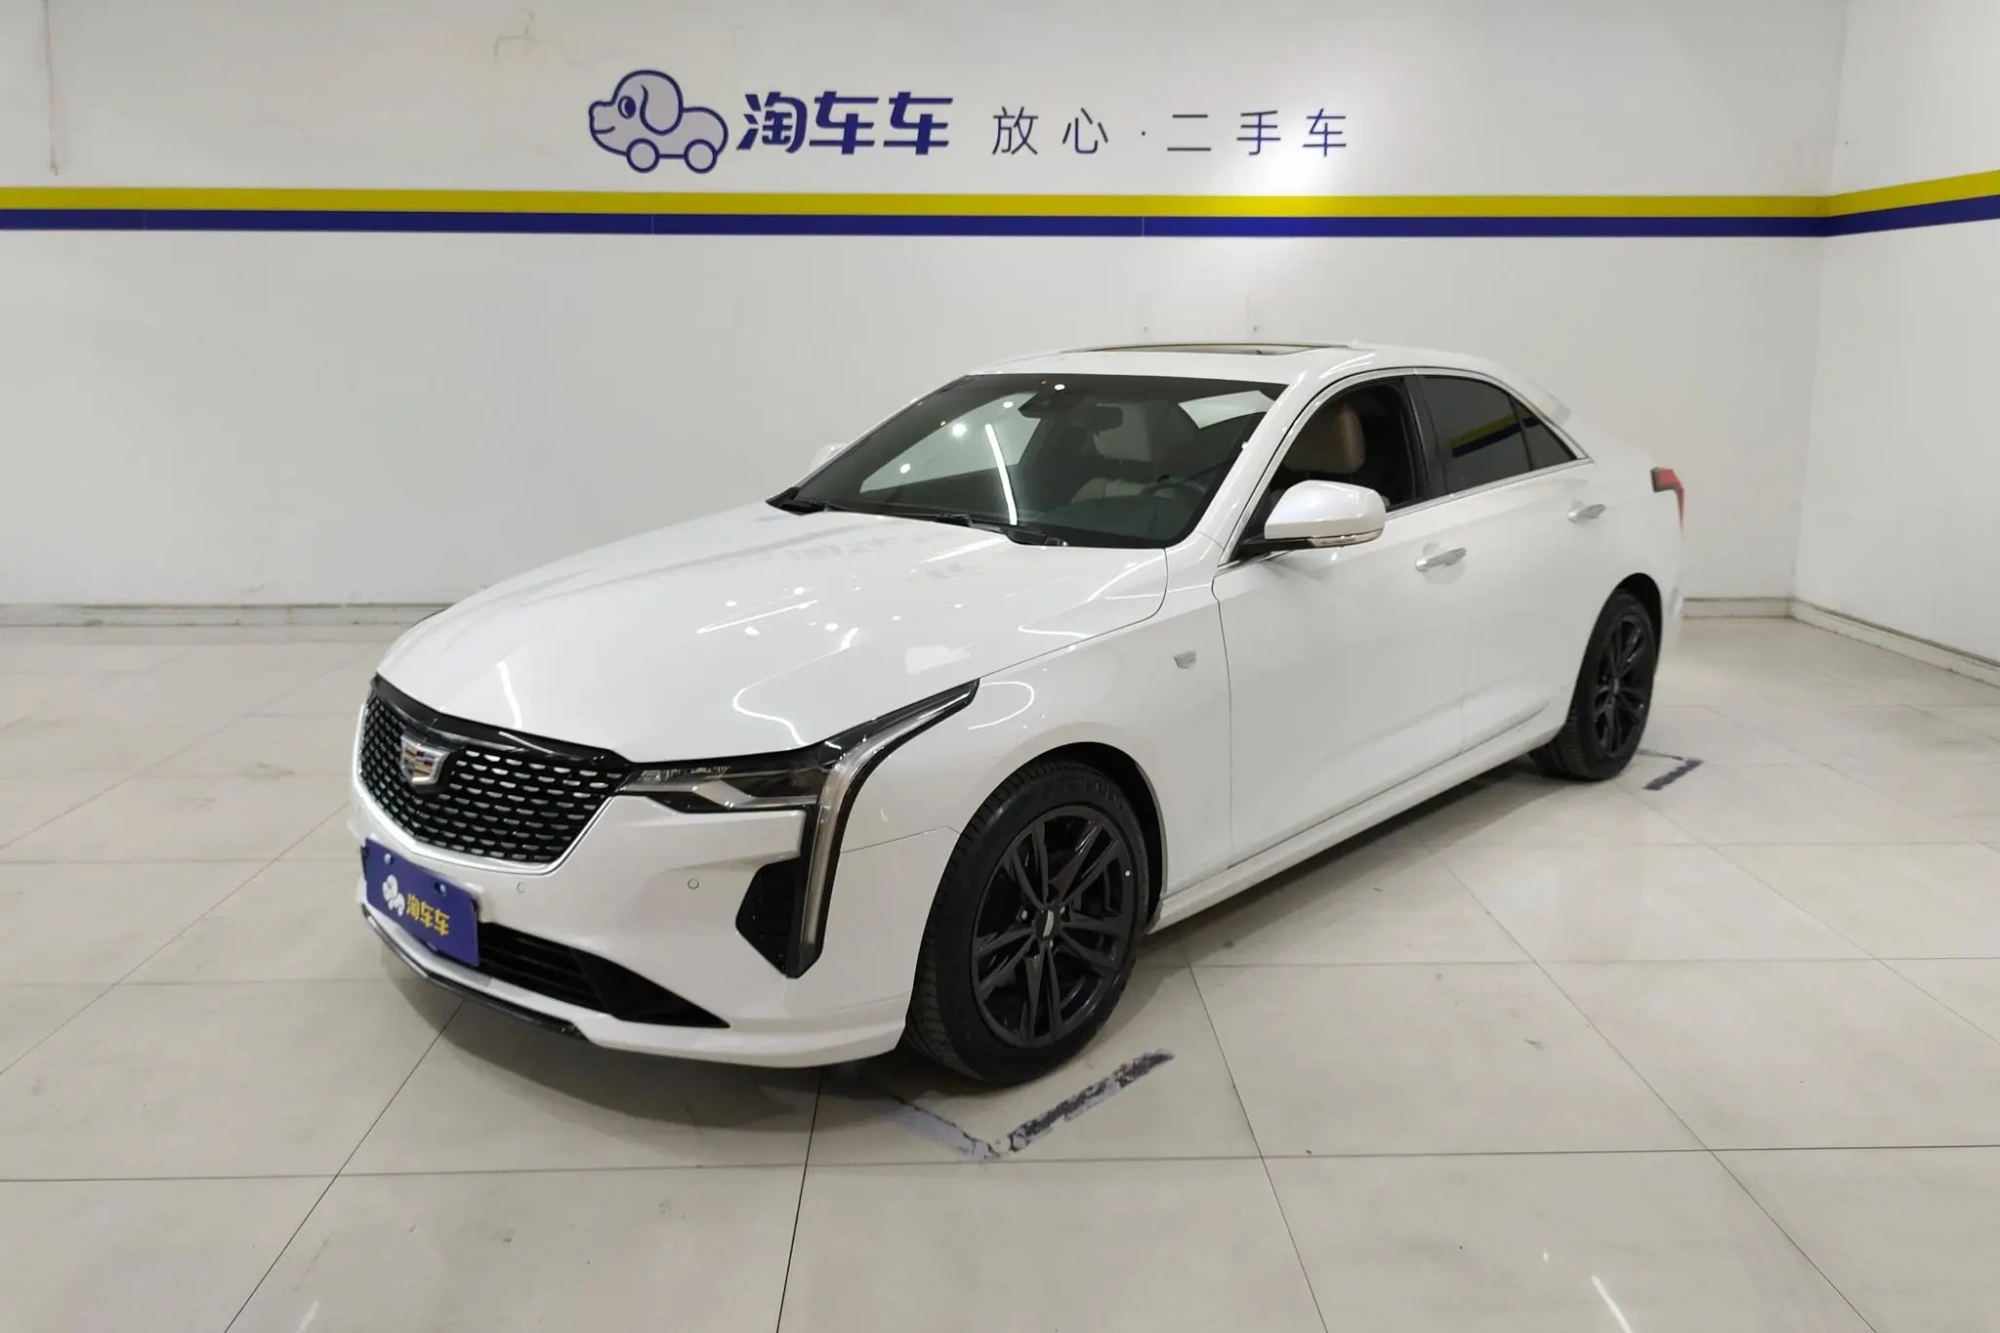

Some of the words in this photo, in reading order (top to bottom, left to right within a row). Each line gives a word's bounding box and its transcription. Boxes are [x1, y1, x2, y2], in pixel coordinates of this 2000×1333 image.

[736, 90, 954, 155] 淘车车
[405, 893, 450, 936] 淘车车
